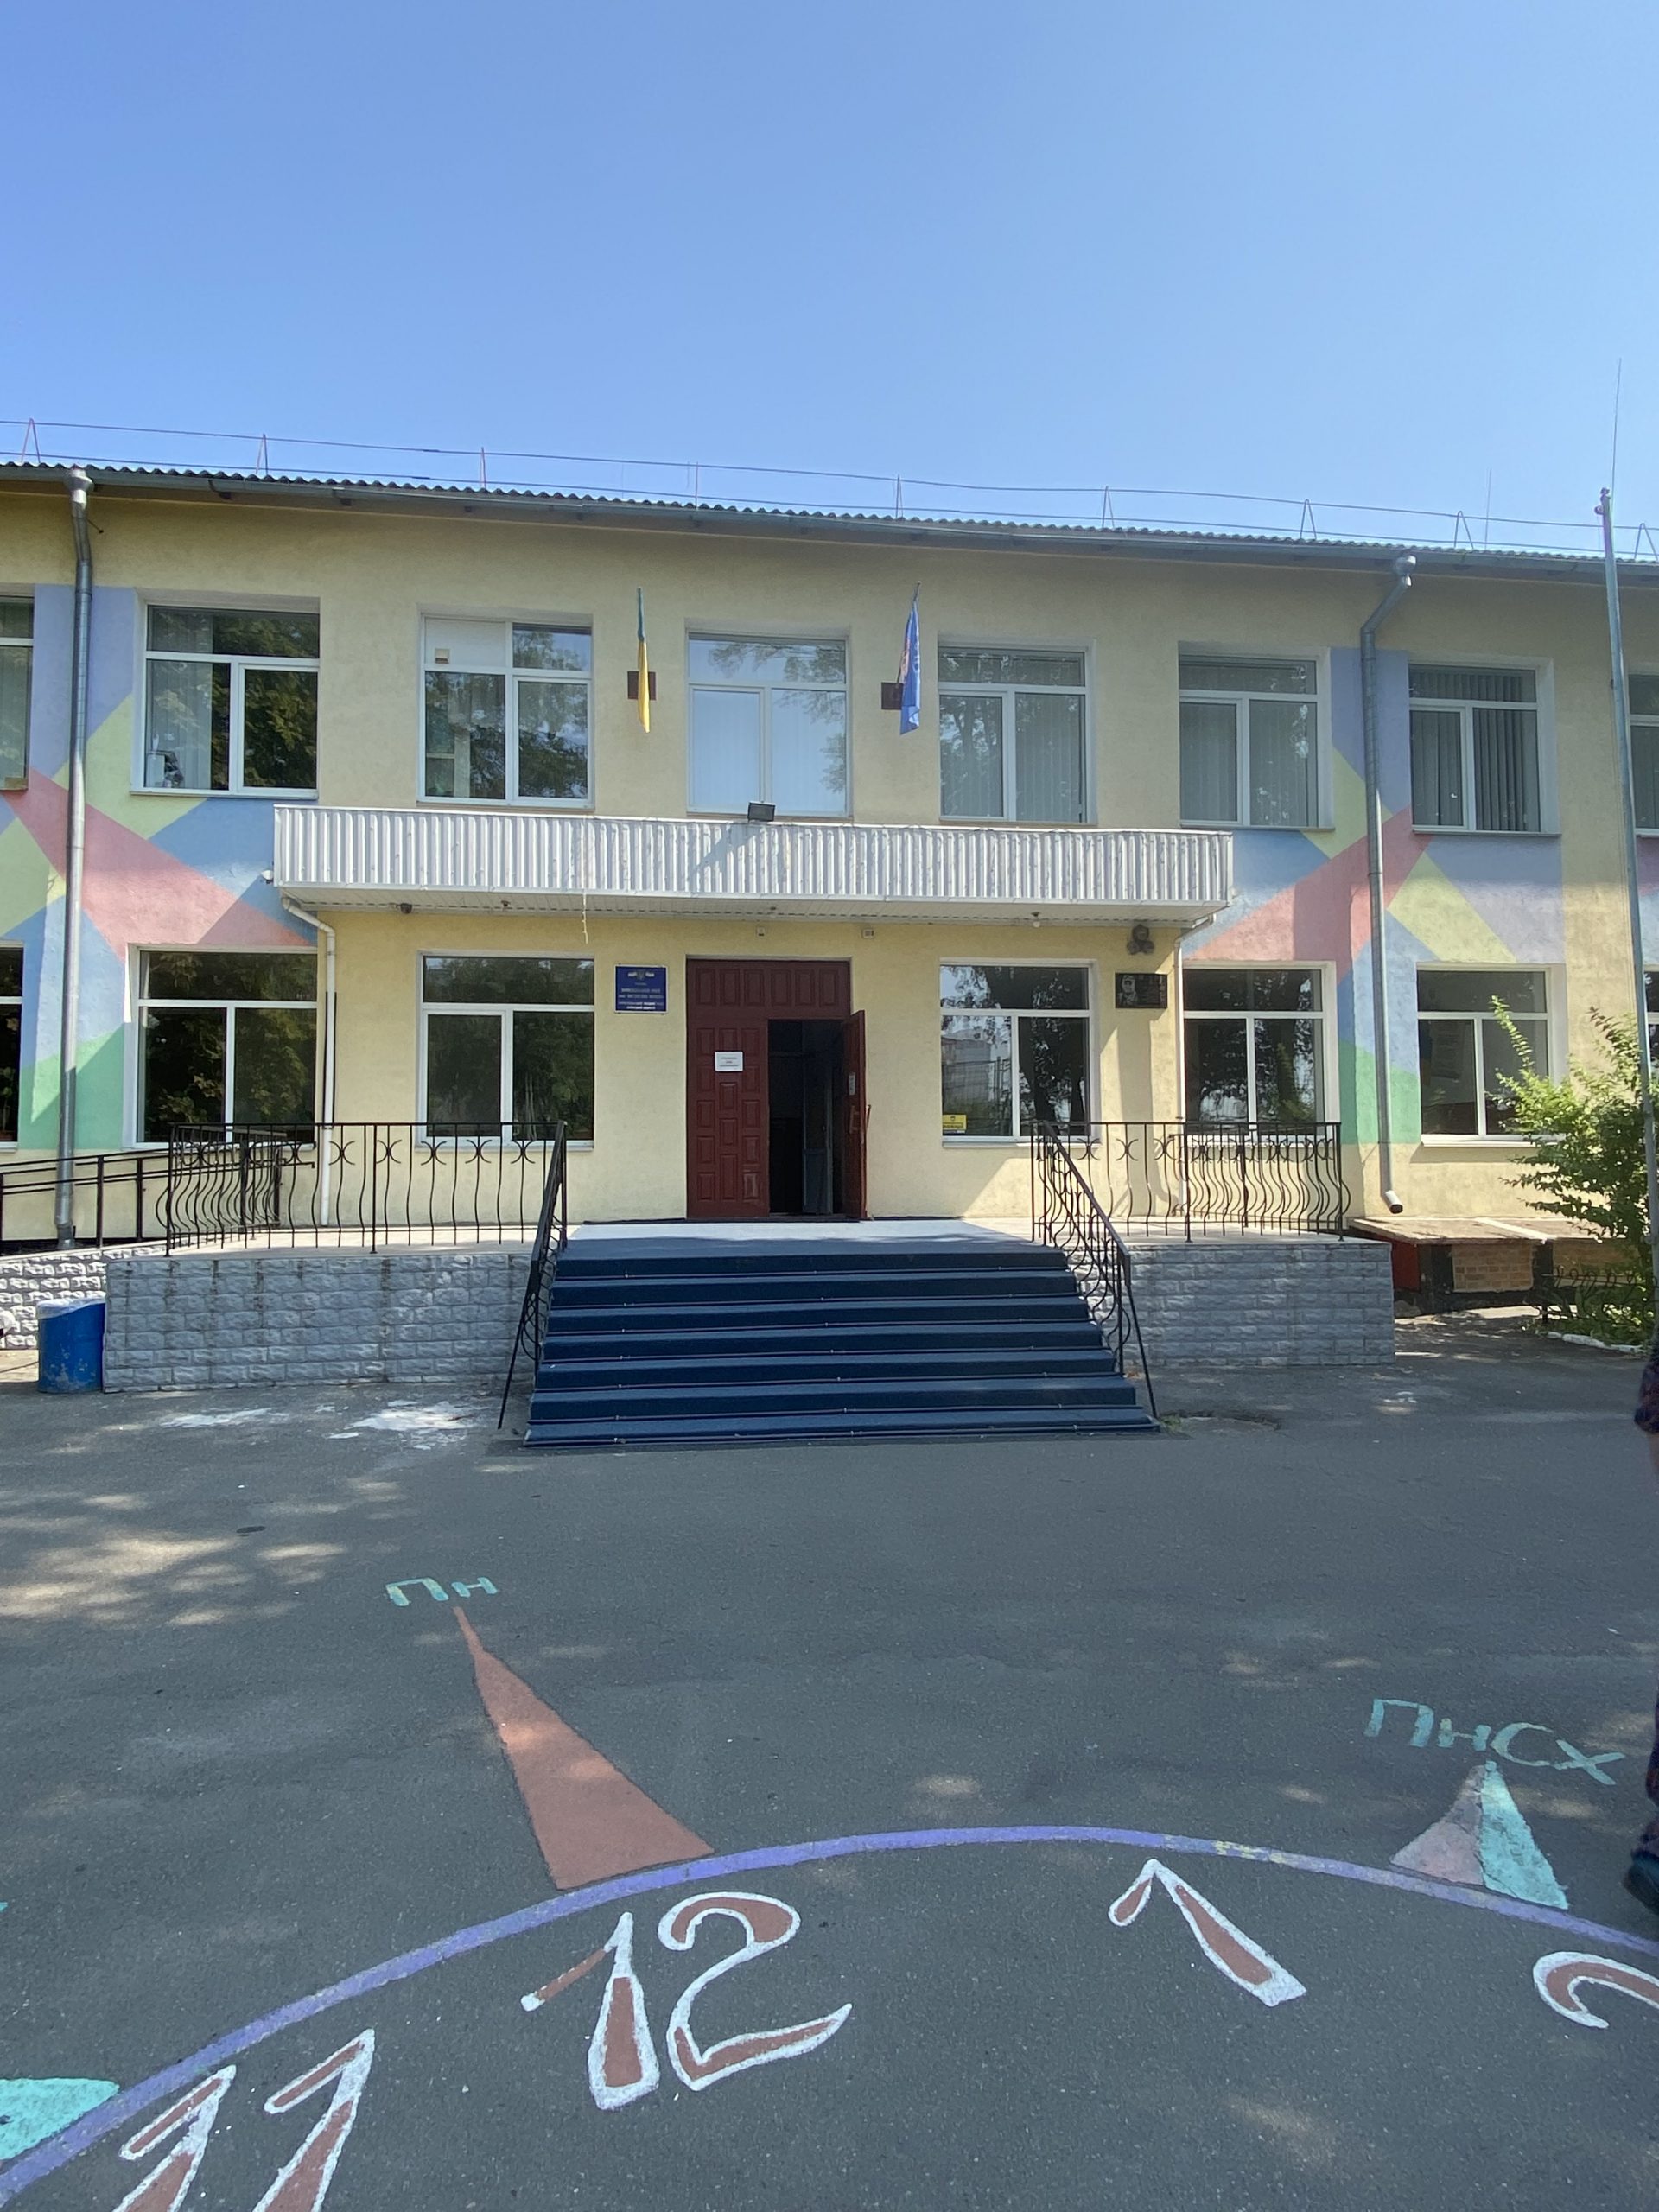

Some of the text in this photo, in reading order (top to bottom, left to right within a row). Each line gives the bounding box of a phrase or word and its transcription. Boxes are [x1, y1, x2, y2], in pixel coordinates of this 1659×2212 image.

[520, 1891, 852, 2110] 12
[1109, 1859, 1306, 2006] 1
[111, 2028, 375, 2212] 11
